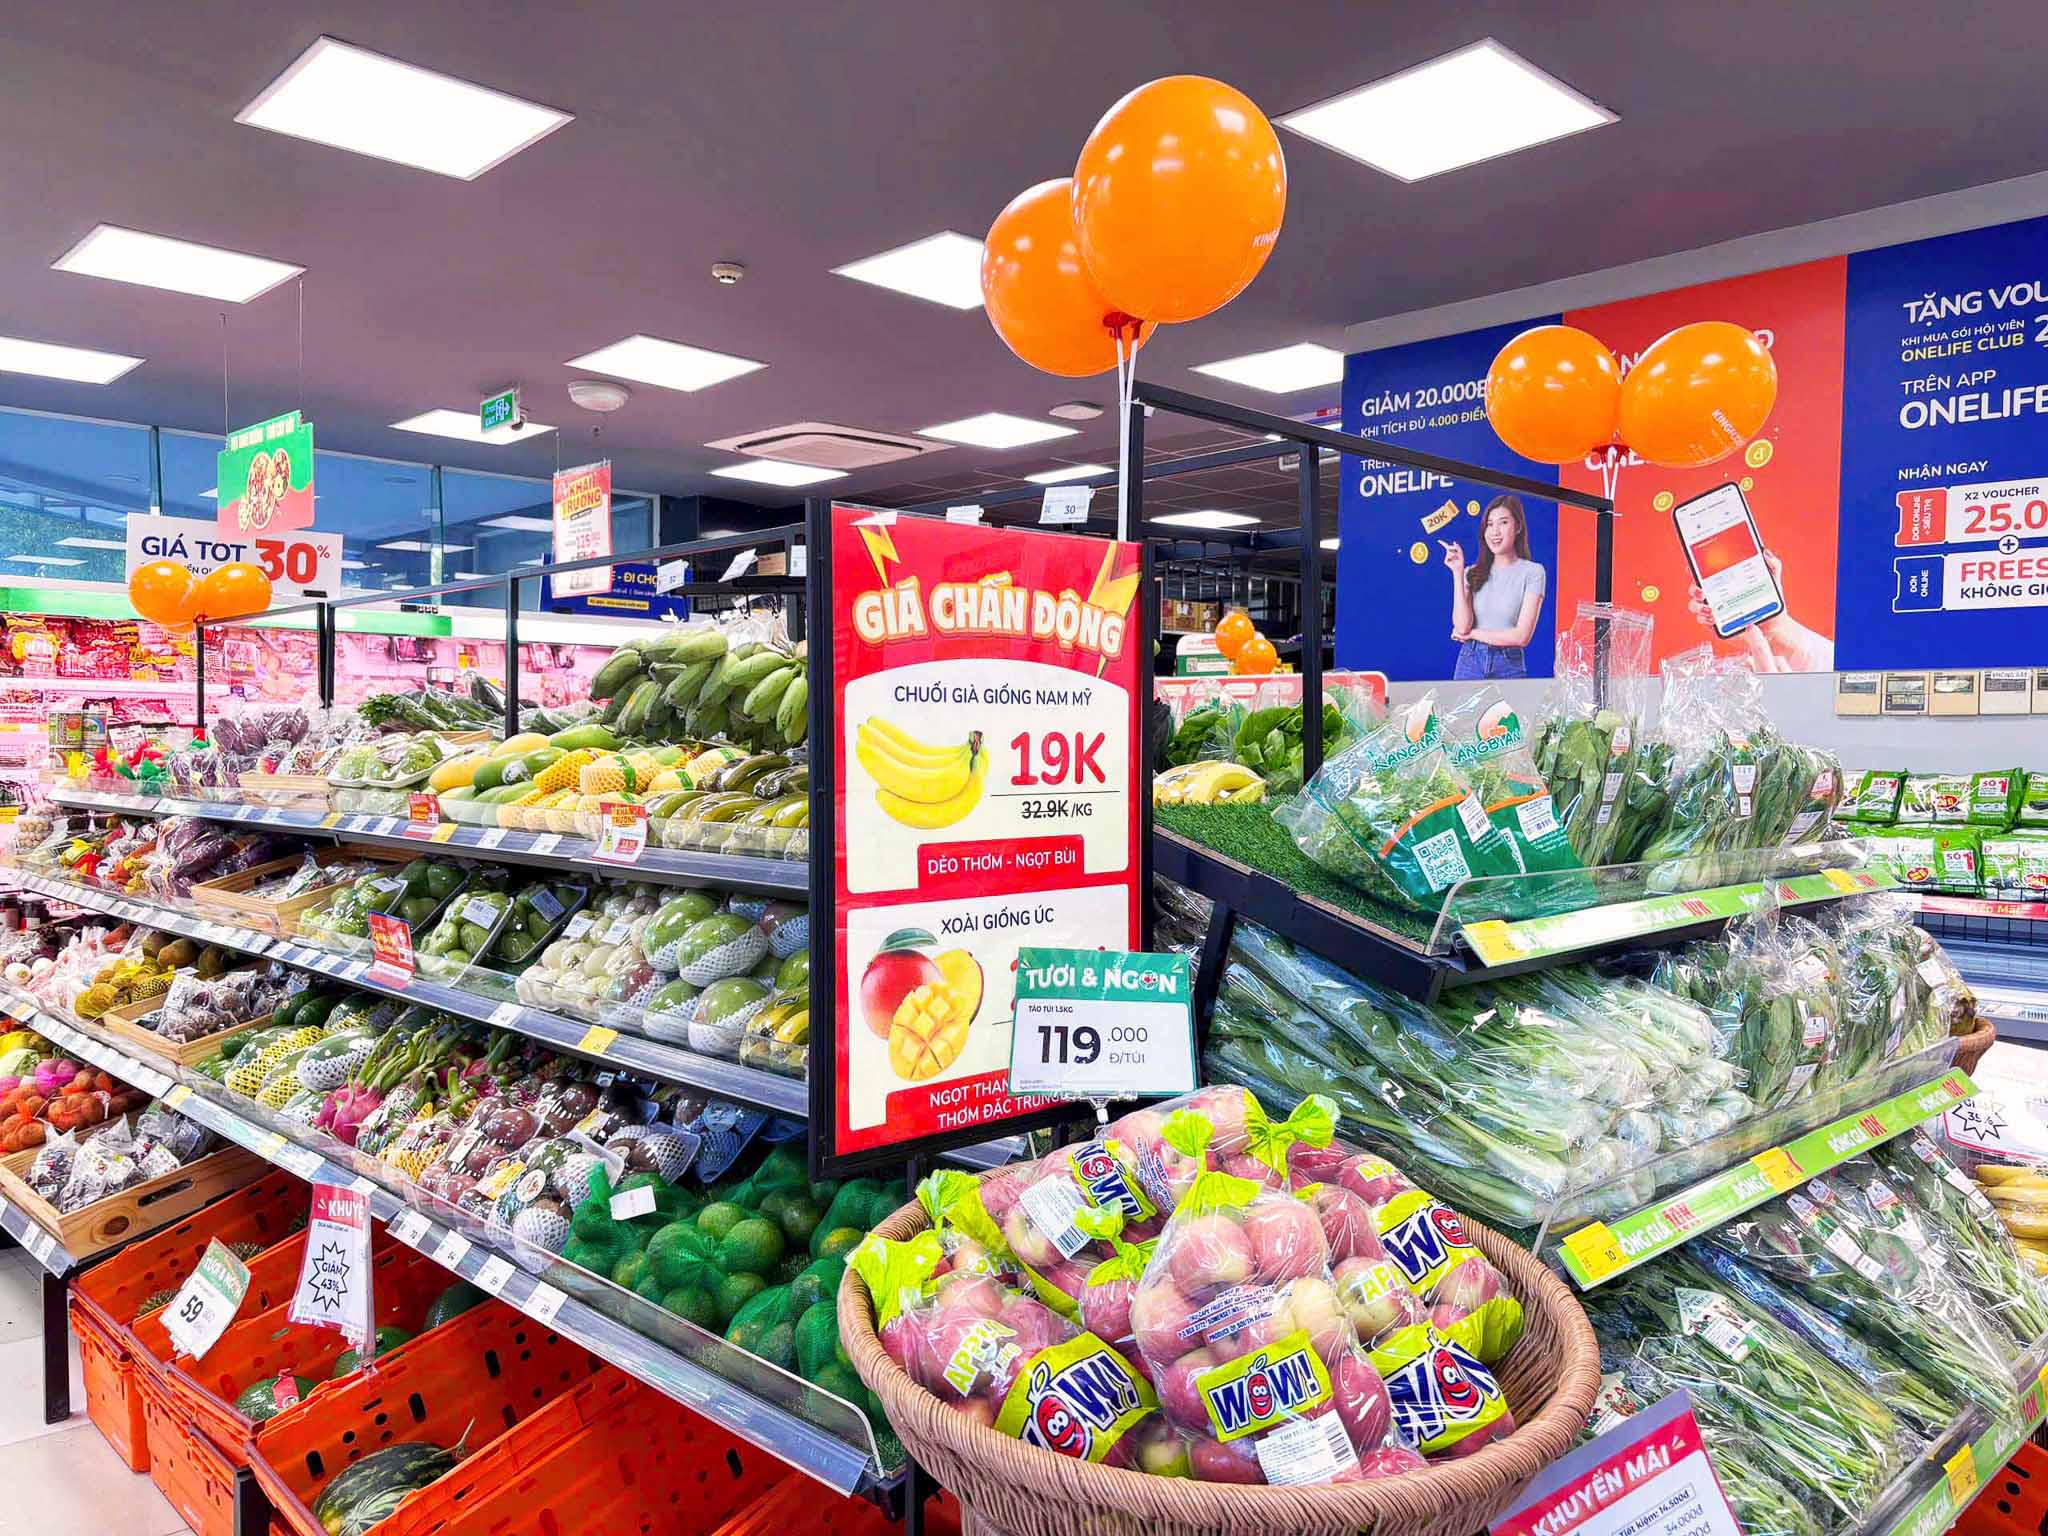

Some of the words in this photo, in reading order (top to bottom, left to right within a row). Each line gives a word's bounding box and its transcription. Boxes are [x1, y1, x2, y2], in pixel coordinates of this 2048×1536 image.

[1903, 291, 1982, 327] TẶNG
[1901, 336, 1920, 347] KHI
[1923, 332, 1949, 344] MUA
[1951, 327, 1971, 339] GÓI
[1974, 323, 1995, 337] HỘI
[1997, 318, 2025, 331] VIÊN
[1901, 340, 1973, 362] ONELIFE
[1977, 332, 2024, 352] CLUB
[1901, 373, 1951, 396] TRÊN
[1956, 369, 1997, 389] APP
[1361, 390, 1410, 417] GIẢM
[1360, 425, 1379, 438] KHI
[1382, 421, 1407, 435] TÍCH
[1409, 415, 1426, 432] ĐỦ
[1429, 412, 1458, 428] 4.000
[1898, 463, 1942, 480] NHẬN
[1946, 460, 1989, 475] NGAY
[1964, 491, 1979, 501] X2
[1982, 486, 2040, 499] VOUCHER
[1427, 511, 1448, 528] 20K
[141, 533, 189, 559] GIÁ
[1960, 583, 2023, 600] KHÔNG
[853, 577, 927, 644] GIÁ
[1033, 588, 1124, 657] ĐỘNG
[894, 681, 947, 704] CHUỐI
[952, 686, 979, 704] GIÀ
[983, 685, 1032, 706] GIỐNG
[1036, 690, 1068, 706] NAM
[1072, 688, 1093, 706] MỸ
[1010, 732, 1106, 786] 19K
[1071, 802, 1093, 818] /KG
[927, 854, 959, 875] DẺO
[962, 849, 1004, 872] THƠM
[1015, 851, 1051, 869] NGỌT
[1054, 847, 1077, 865] BÙI
[940, 915, 978, 935] XOÀI
[983, 908, 1031, 930] GIỐNG
[1034, 905, 1055, 924] ÚC
[1026, 963, 1075, 990] TƯƠI
[1081, 967, 1098, 988] &
[1038, 1025, 1101, 1065] 119
[1107, 1026, 1148, 1042] .000
[1109, 1051, 1145, 1064] Đ/TÚI
[930, 1086, 970, 1108] NGỌT
[937, 1106, 979, 1129] THƠM
[983, 1099, 1012, 1120] ĐẶC
[321, 1260, 343, 1276] GIẢM
[1605, 1249, 1617, 1262] 10
[320, 1278, 340, 1293] 43%
[180, 1294, 204, 1324] 59
[1208, 1354, 1321, 1434] WOW!
[1531, 1467, 1625, 1536] KHUYẾN
[1625, 1444, 1672, 1482] MÃI
